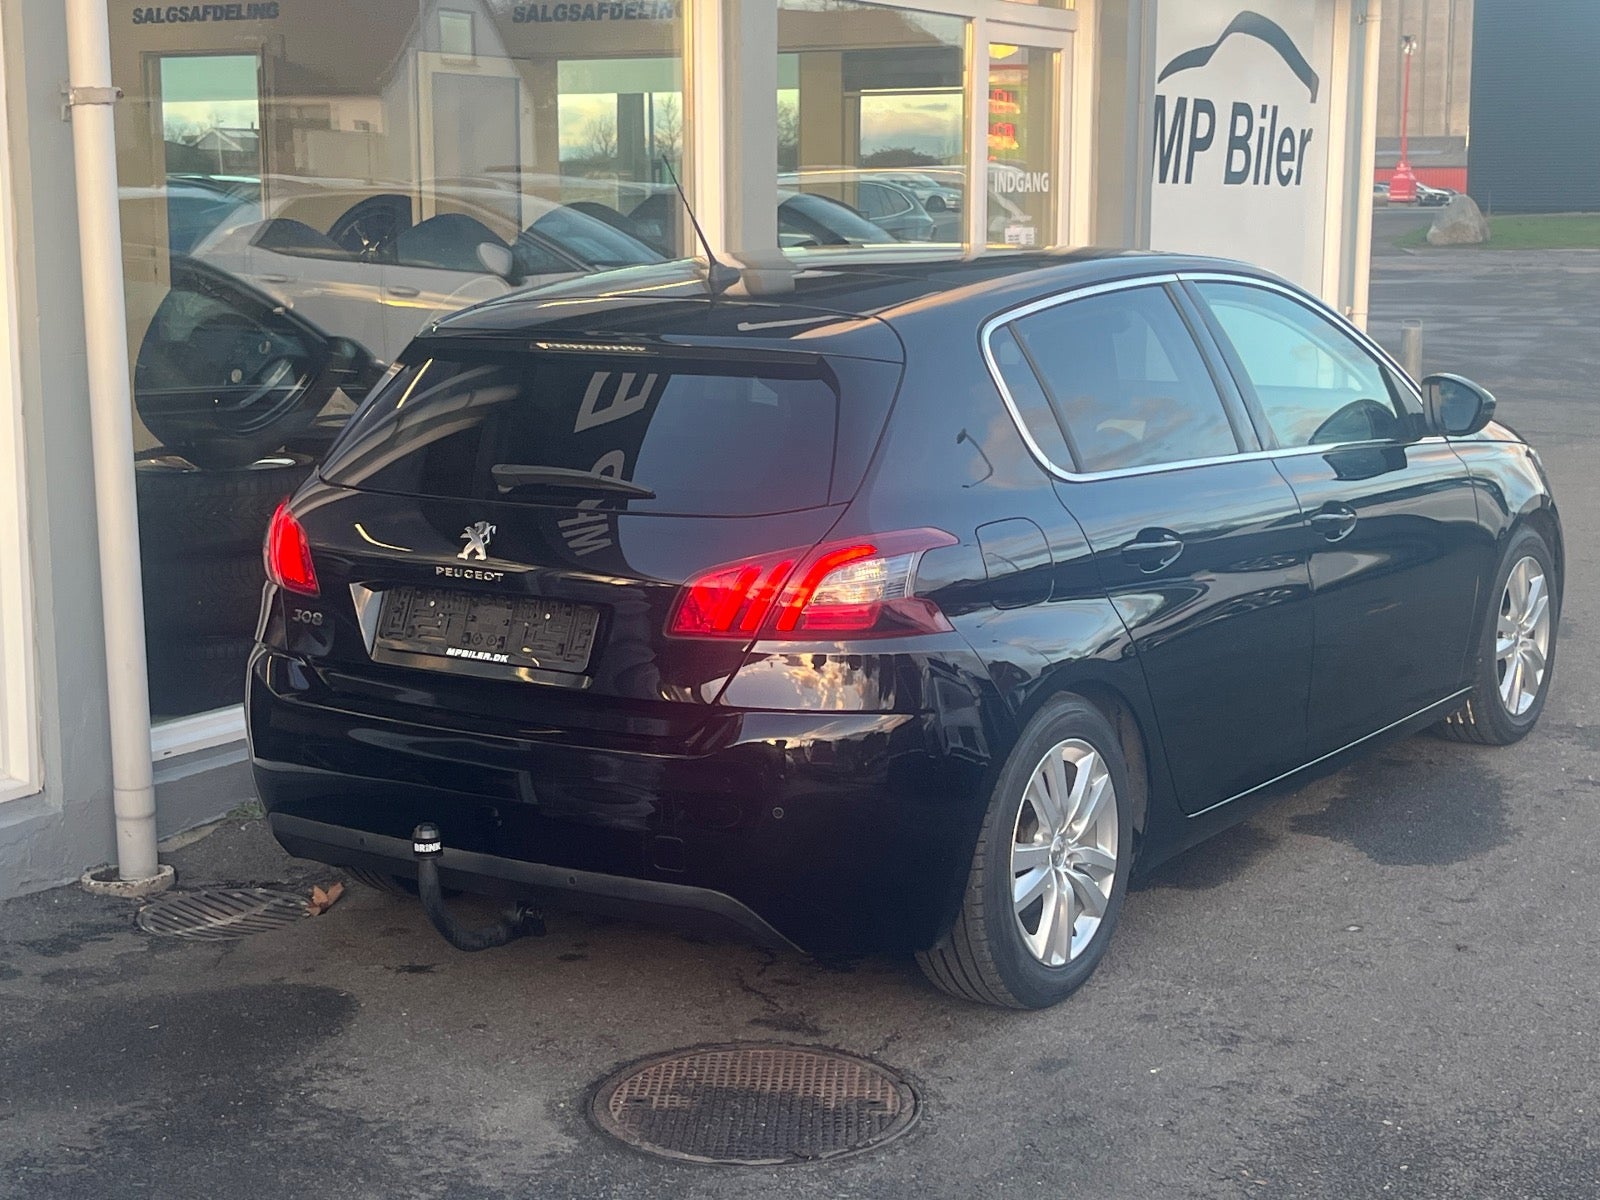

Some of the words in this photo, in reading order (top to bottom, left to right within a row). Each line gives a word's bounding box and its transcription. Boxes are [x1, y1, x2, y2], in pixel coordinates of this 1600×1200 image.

[132, 2, 280, 24] SALGSAFDELING
[1151, 94, 1216, 185] MP
[1223, 101, 1314, 187] Biler
[994, 172, 1049, 193] INDGANG
[435, 566, 504, 582] PEUGEOT
[291, 608, 324, 626] 308
[446, 647, 510, 663] MPBILER.DK
[414, 841, 441, 853] BRINK
